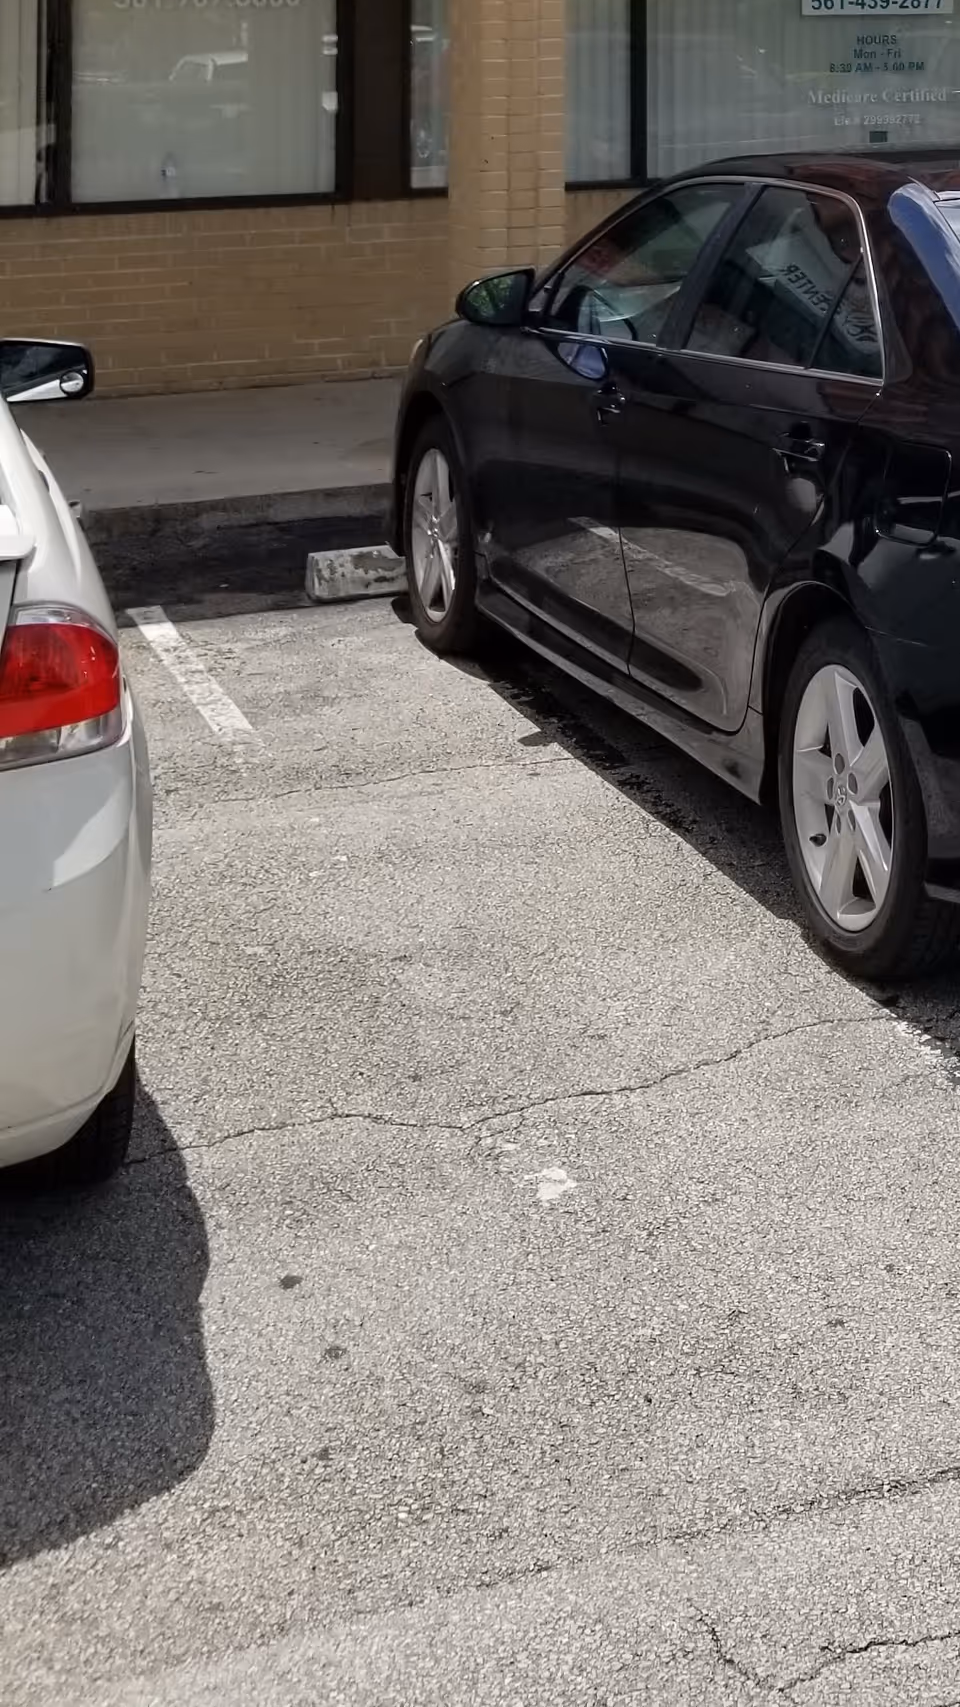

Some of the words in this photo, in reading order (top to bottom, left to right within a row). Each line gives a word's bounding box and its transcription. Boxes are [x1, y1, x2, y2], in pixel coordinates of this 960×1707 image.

[856, 35, 897, 45] HOURS
[853, 49, 877, 59] Mon
[887, 48, 902, 59] Fri
[855, 62, 873, 73] AM
[908, 61, 925, 71] PM
[808, 90, 878, 104] Medicare
[883, 88, 947, 103] Certified
